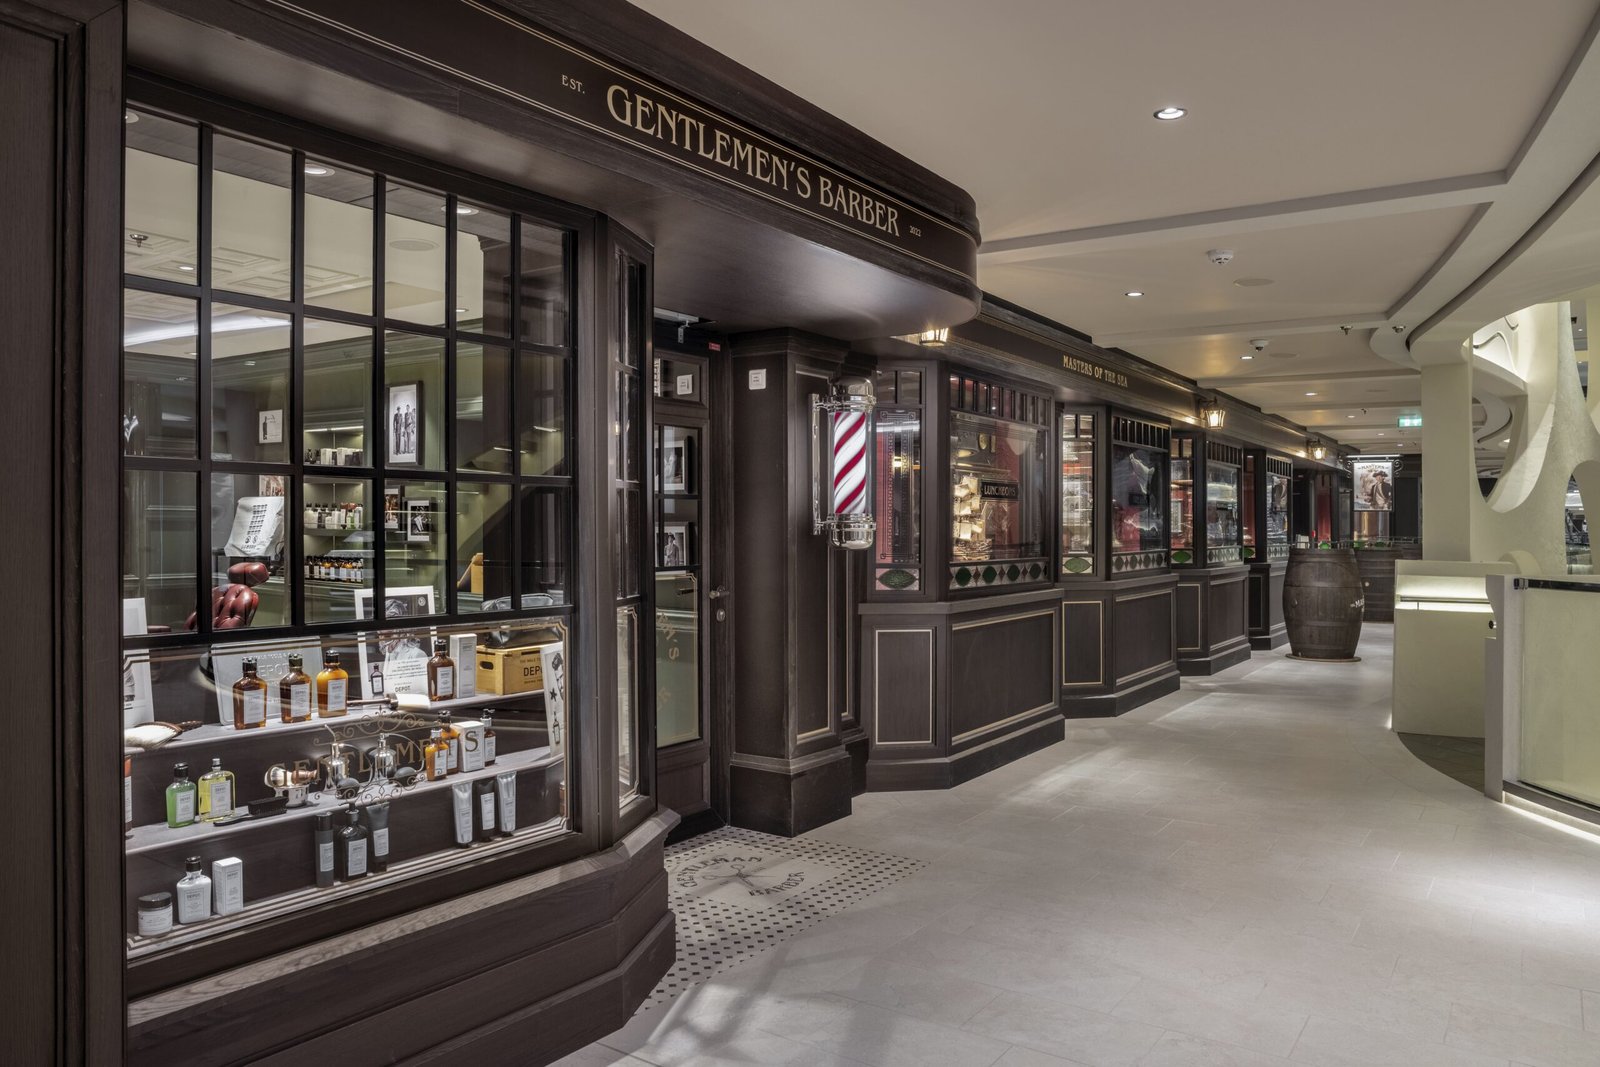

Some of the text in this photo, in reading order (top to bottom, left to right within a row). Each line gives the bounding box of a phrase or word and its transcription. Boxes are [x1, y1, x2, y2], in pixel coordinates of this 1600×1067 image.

[562, 74, 586, 95] EST.
[607, 84, 901, 237] GENTLEMEN'S BARBER
[1063, 355, 1128, 388] MASTERS OF THE SEA
[523, 665, 543, 677] DEP
